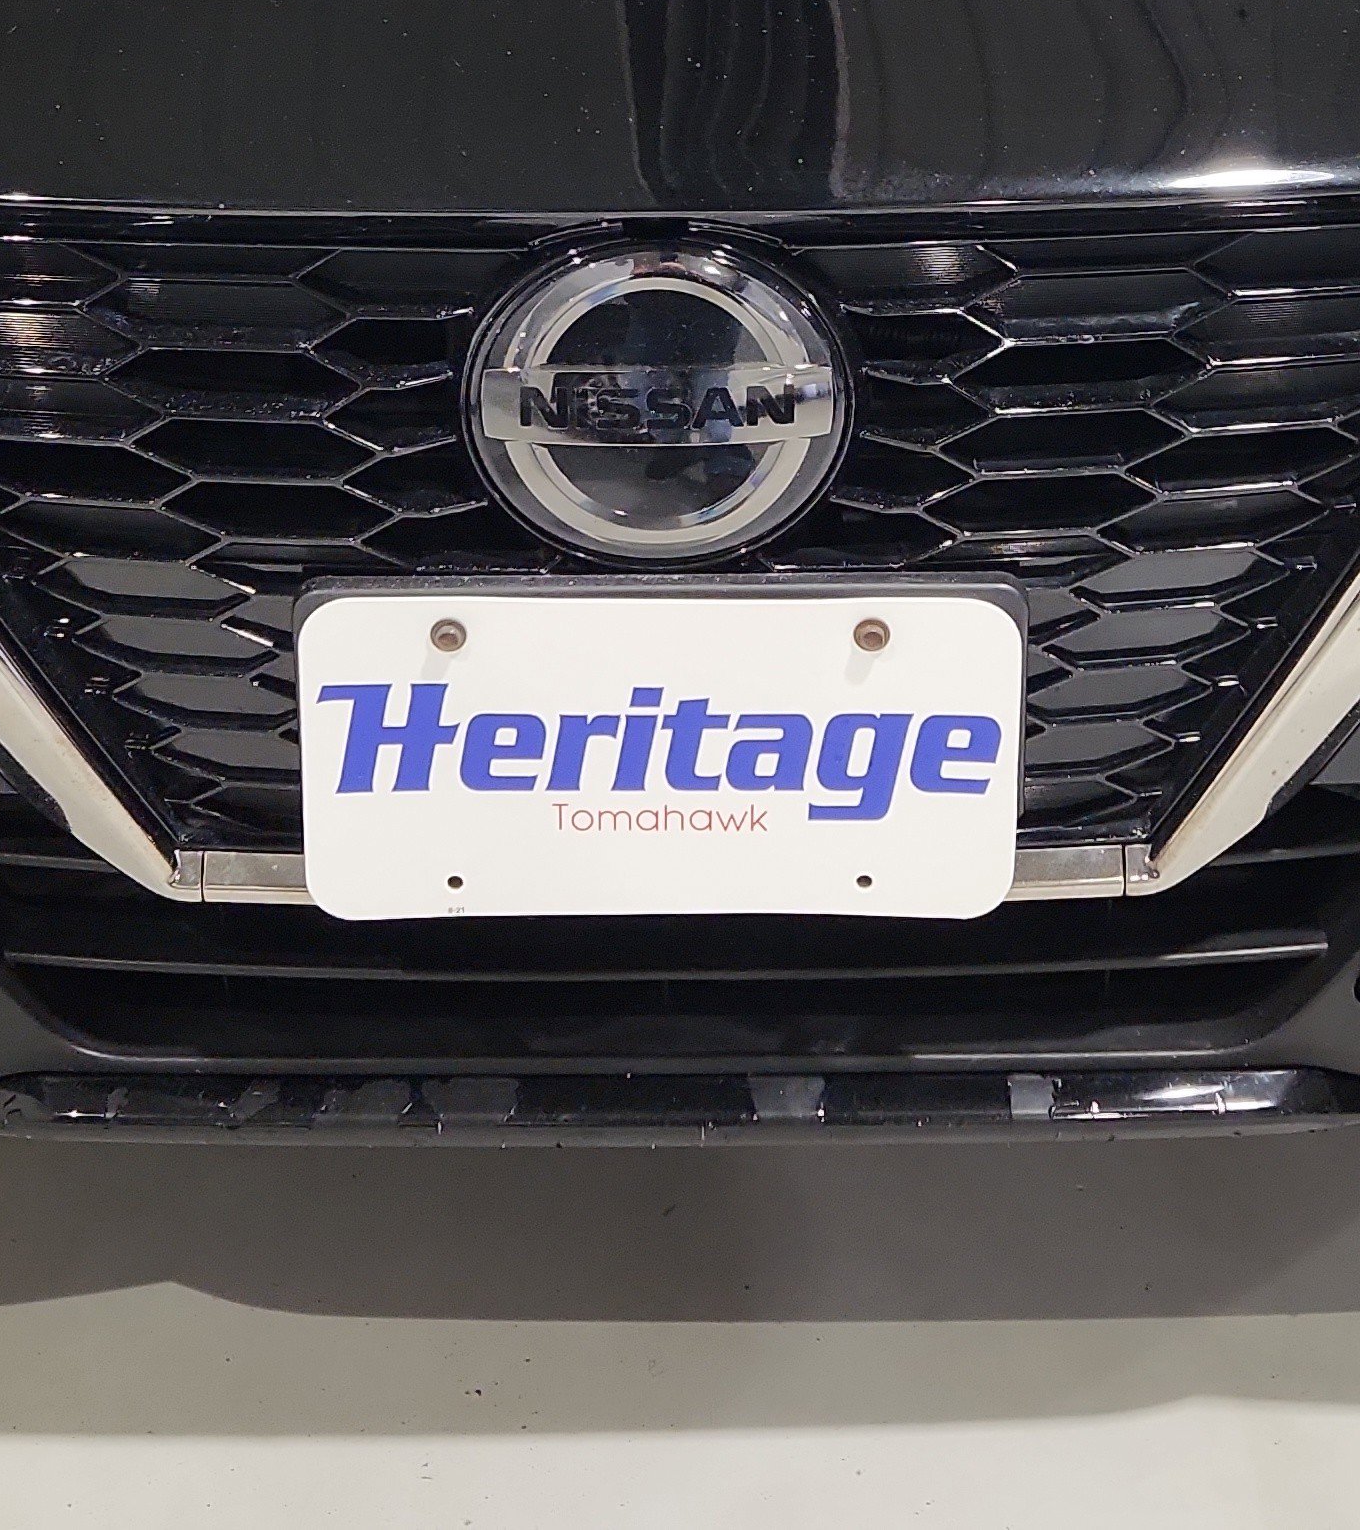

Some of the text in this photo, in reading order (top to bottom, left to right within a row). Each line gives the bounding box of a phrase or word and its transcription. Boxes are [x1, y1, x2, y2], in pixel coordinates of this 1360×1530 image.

[518, 384, 796, 430] NISSAN
[316, 683, 1002, 822] Heritage
[551, 802, 769, 833] Tomahawk
